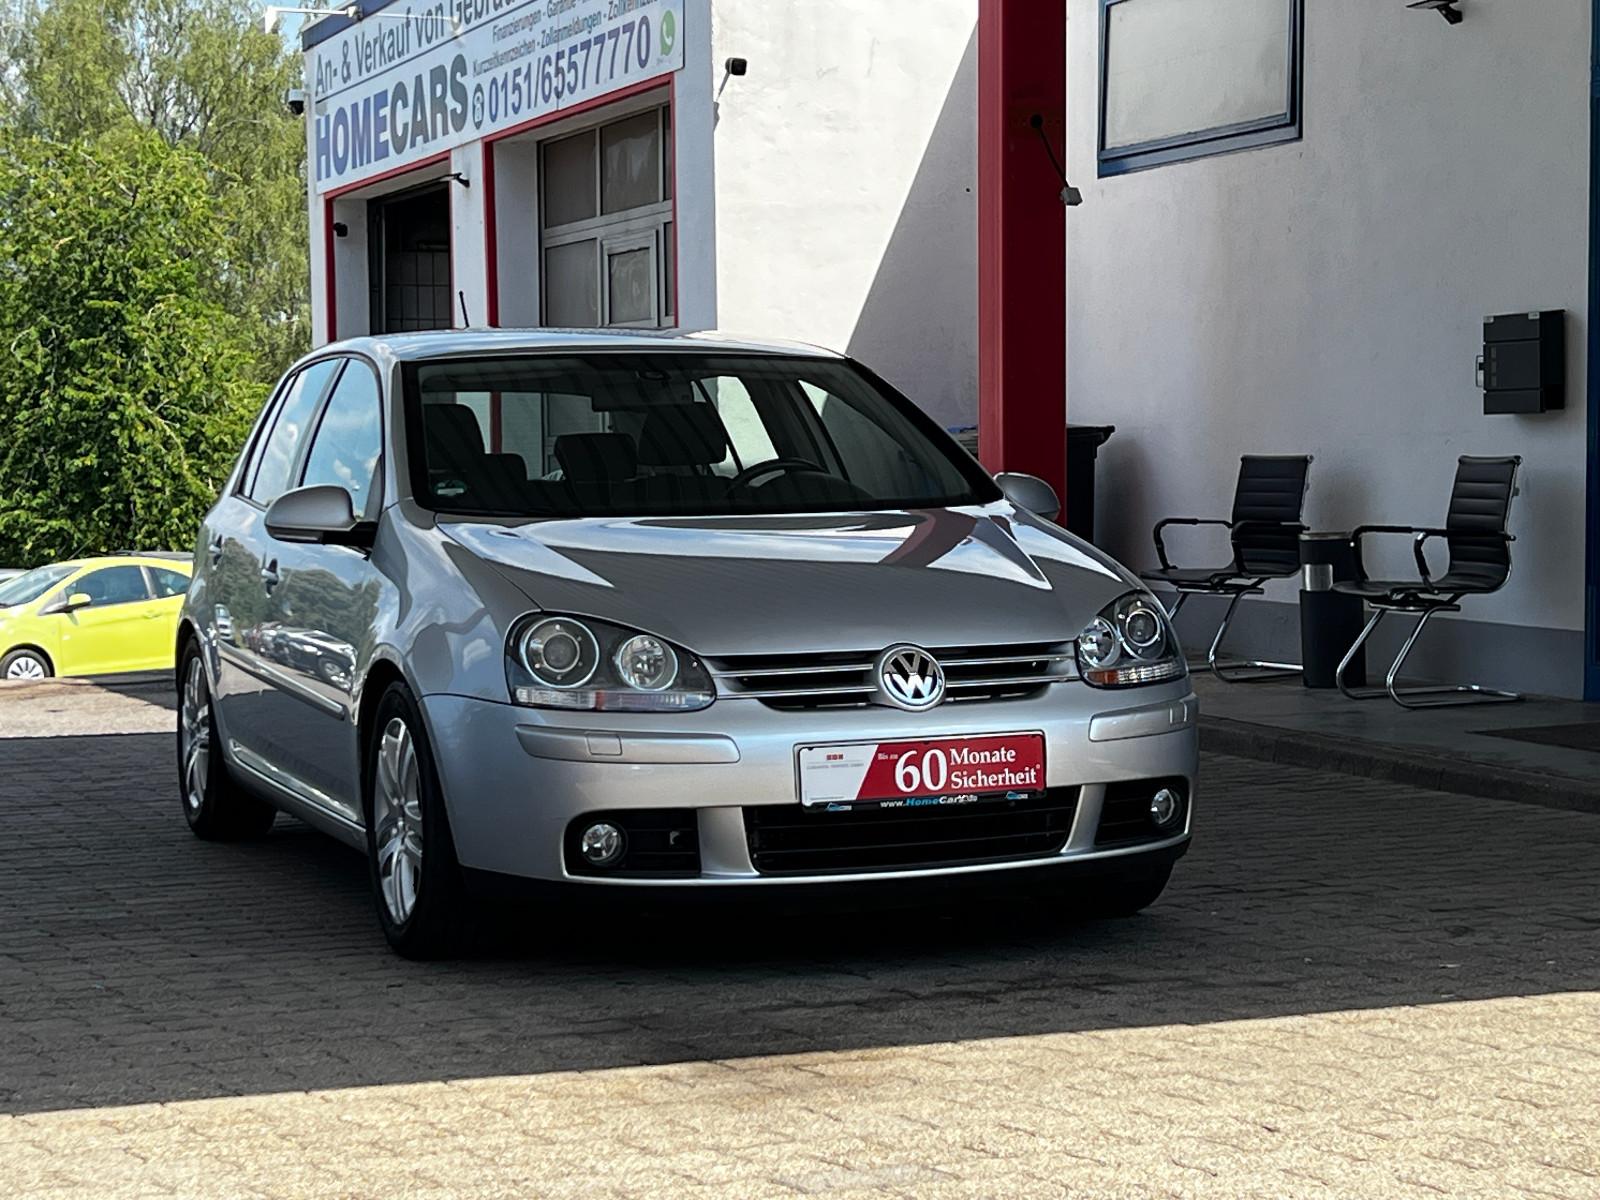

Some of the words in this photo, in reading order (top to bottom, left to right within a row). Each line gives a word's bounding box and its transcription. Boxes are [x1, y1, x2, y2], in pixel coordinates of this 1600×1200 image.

[315, 53, 338, 97] An-
[341, 40, 352, 84] &
[355, 7, 411, 76] Verkauf
[415, 3, 444, 48] von
[315, 53, 469, 182] HOMECARS
[489, 15, 651, 123] 0151/65577770
[895, 749, 948, 792] 60
[949, 747, 1016, 766] Monate
